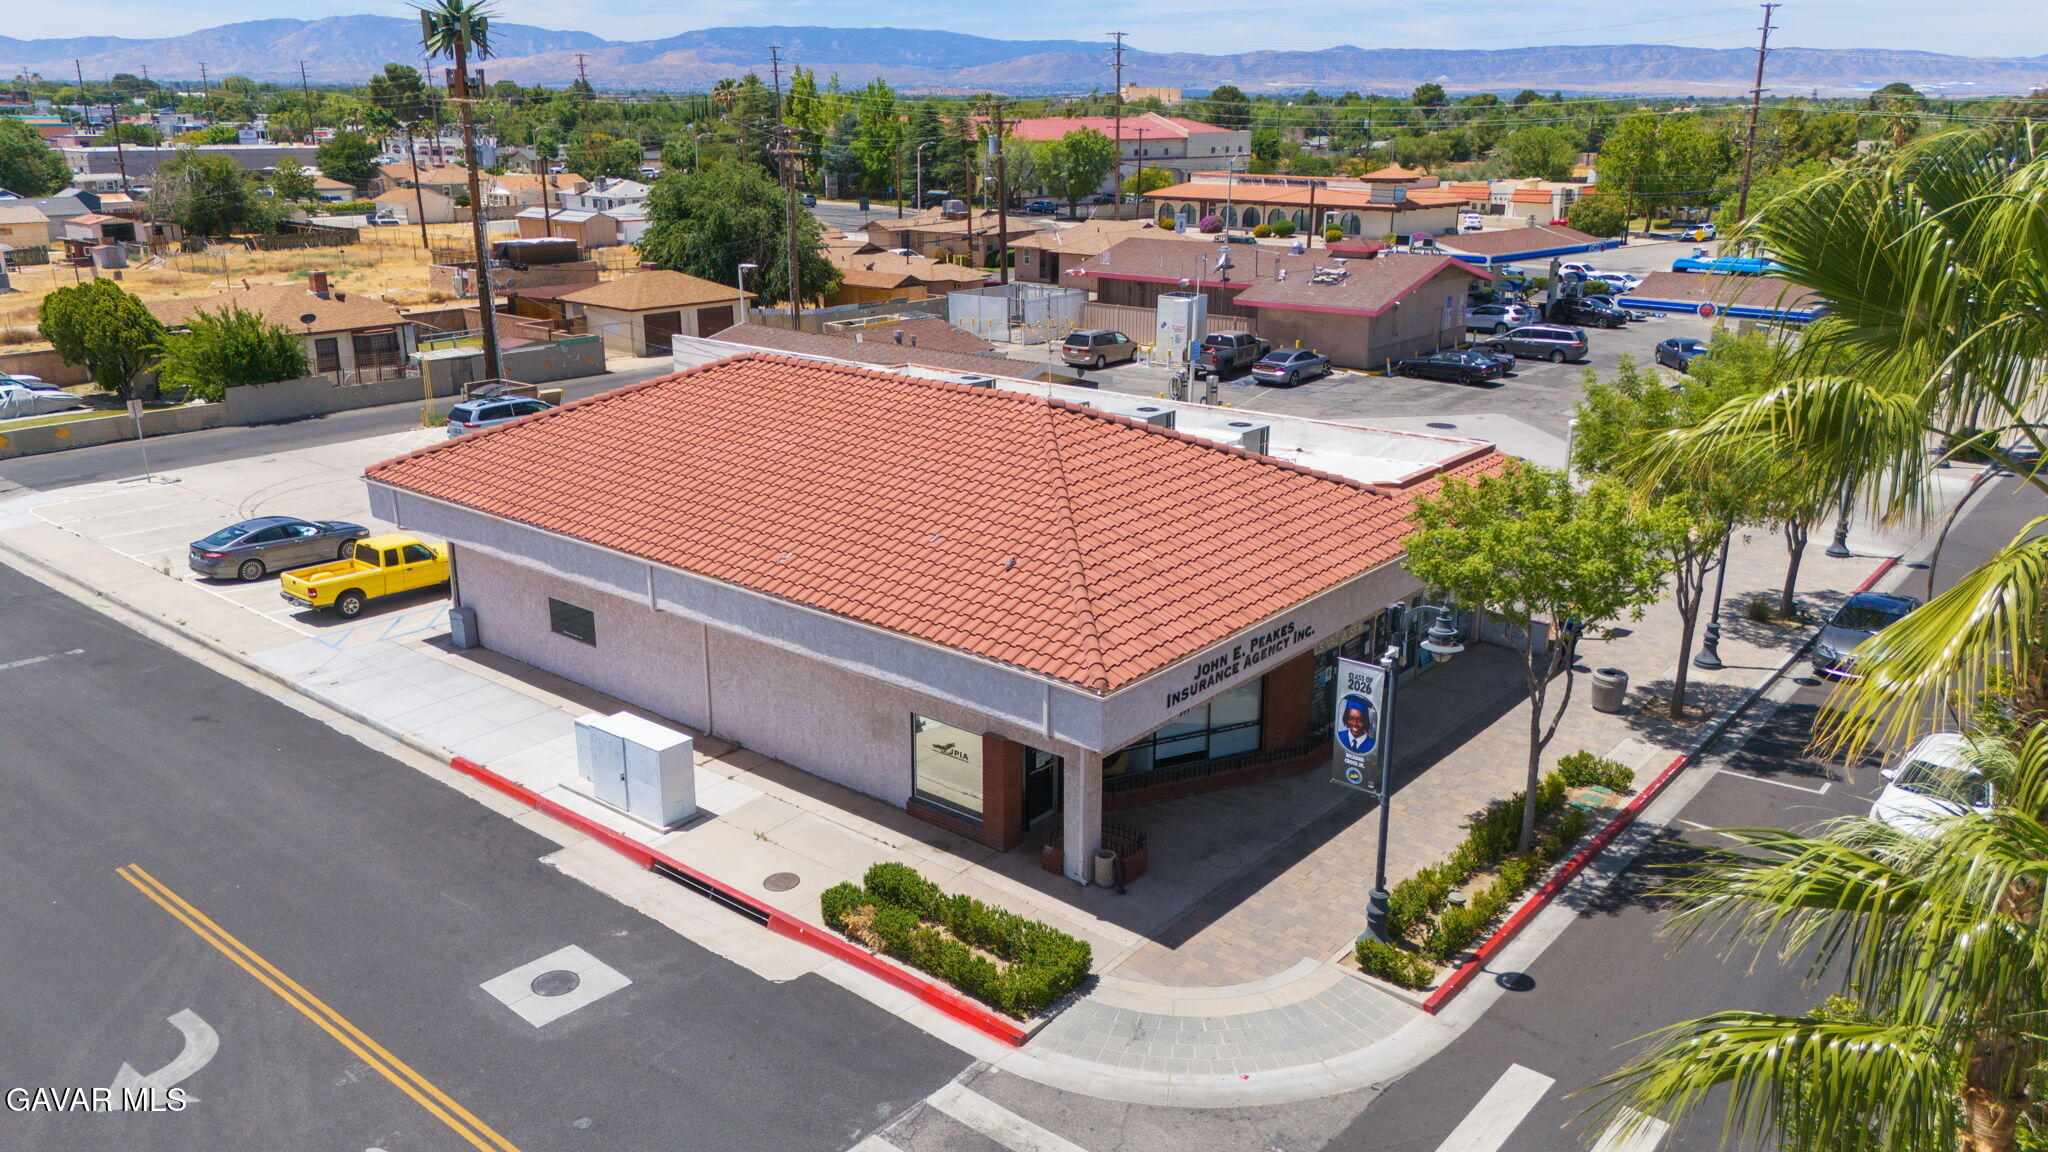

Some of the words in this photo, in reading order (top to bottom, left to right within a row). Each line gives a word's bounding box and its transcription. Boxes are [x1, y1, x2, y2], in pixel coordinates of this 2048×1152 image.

[1194, 654, 1228, 680] JOHN
[1233, 645, 1246, 660] E.
[1250, 622, 1295, 652] PEAKES
[1167, 662, 1240, 709] INSURANCE
[1243, 637, 1290, 669] AGENCY
[1293, 626, 1315, 645] INC.
[1347, 678, 1372, 695] 2026
[1348, 672, 1365, 682] CLASS
[1365, 676, 1374, 684] OF
[949, 748, 969, 760] JPIA
